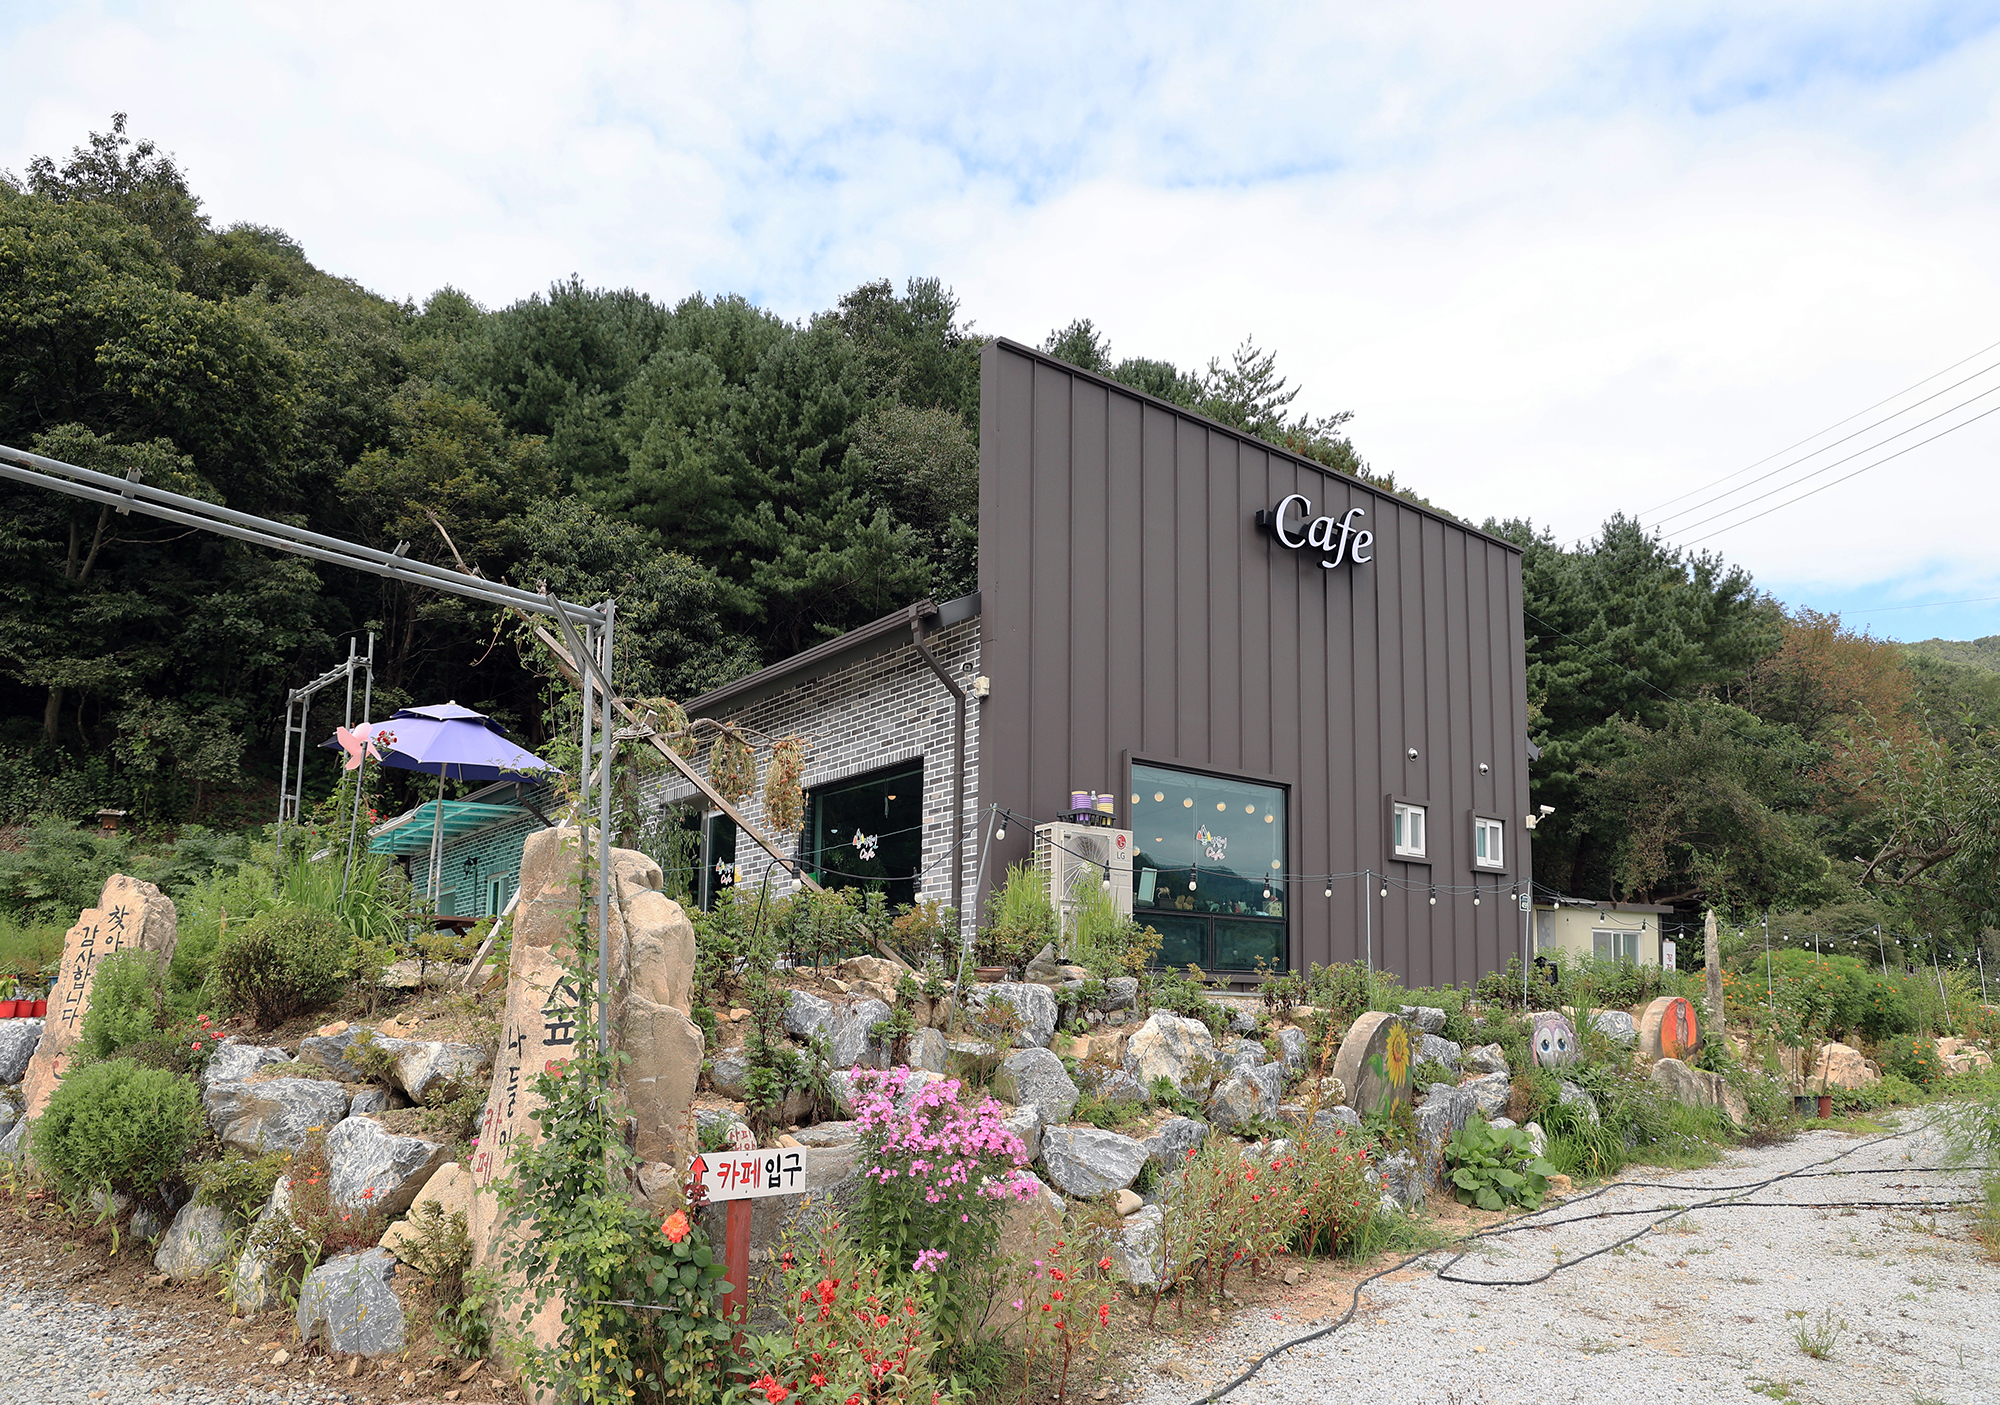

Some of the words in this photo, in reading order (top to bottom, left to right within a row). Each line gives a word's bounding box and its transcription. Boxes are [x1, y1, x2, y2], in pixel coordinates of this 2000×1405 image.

[1275, 493, 1374, 569] Cafe
[1116, 851, 1126, 860] LG
[61, 924, 99, 1029] 감사합니다
[540, 975, 579, 1046] 숲
[499, 1018, 527, 1160] 나들이
[475, 1102, 503, 1187] 카페
